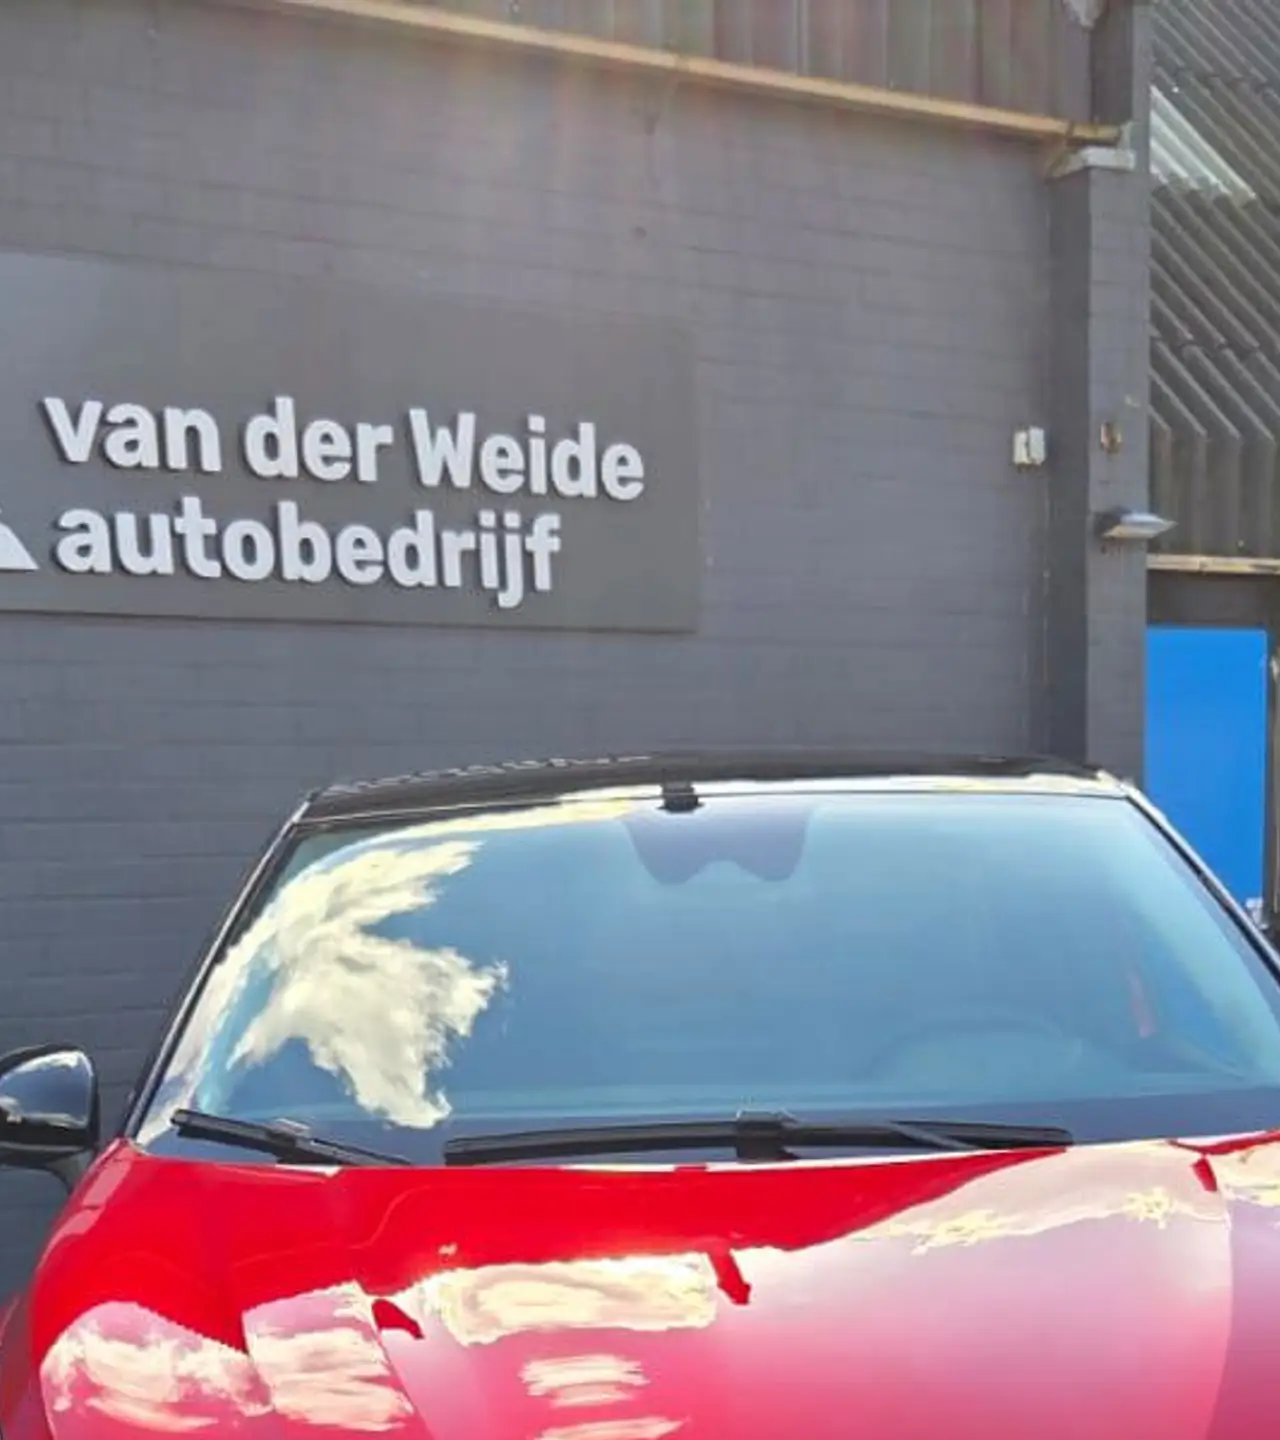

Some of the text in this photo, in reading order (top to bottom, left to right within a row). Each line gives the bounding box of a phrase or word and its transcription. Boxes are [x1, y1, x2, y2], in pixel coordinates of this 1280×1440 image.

[44, 396, 645, 500] van der Weide
[57, 496, 562, 608] autobedrijf
